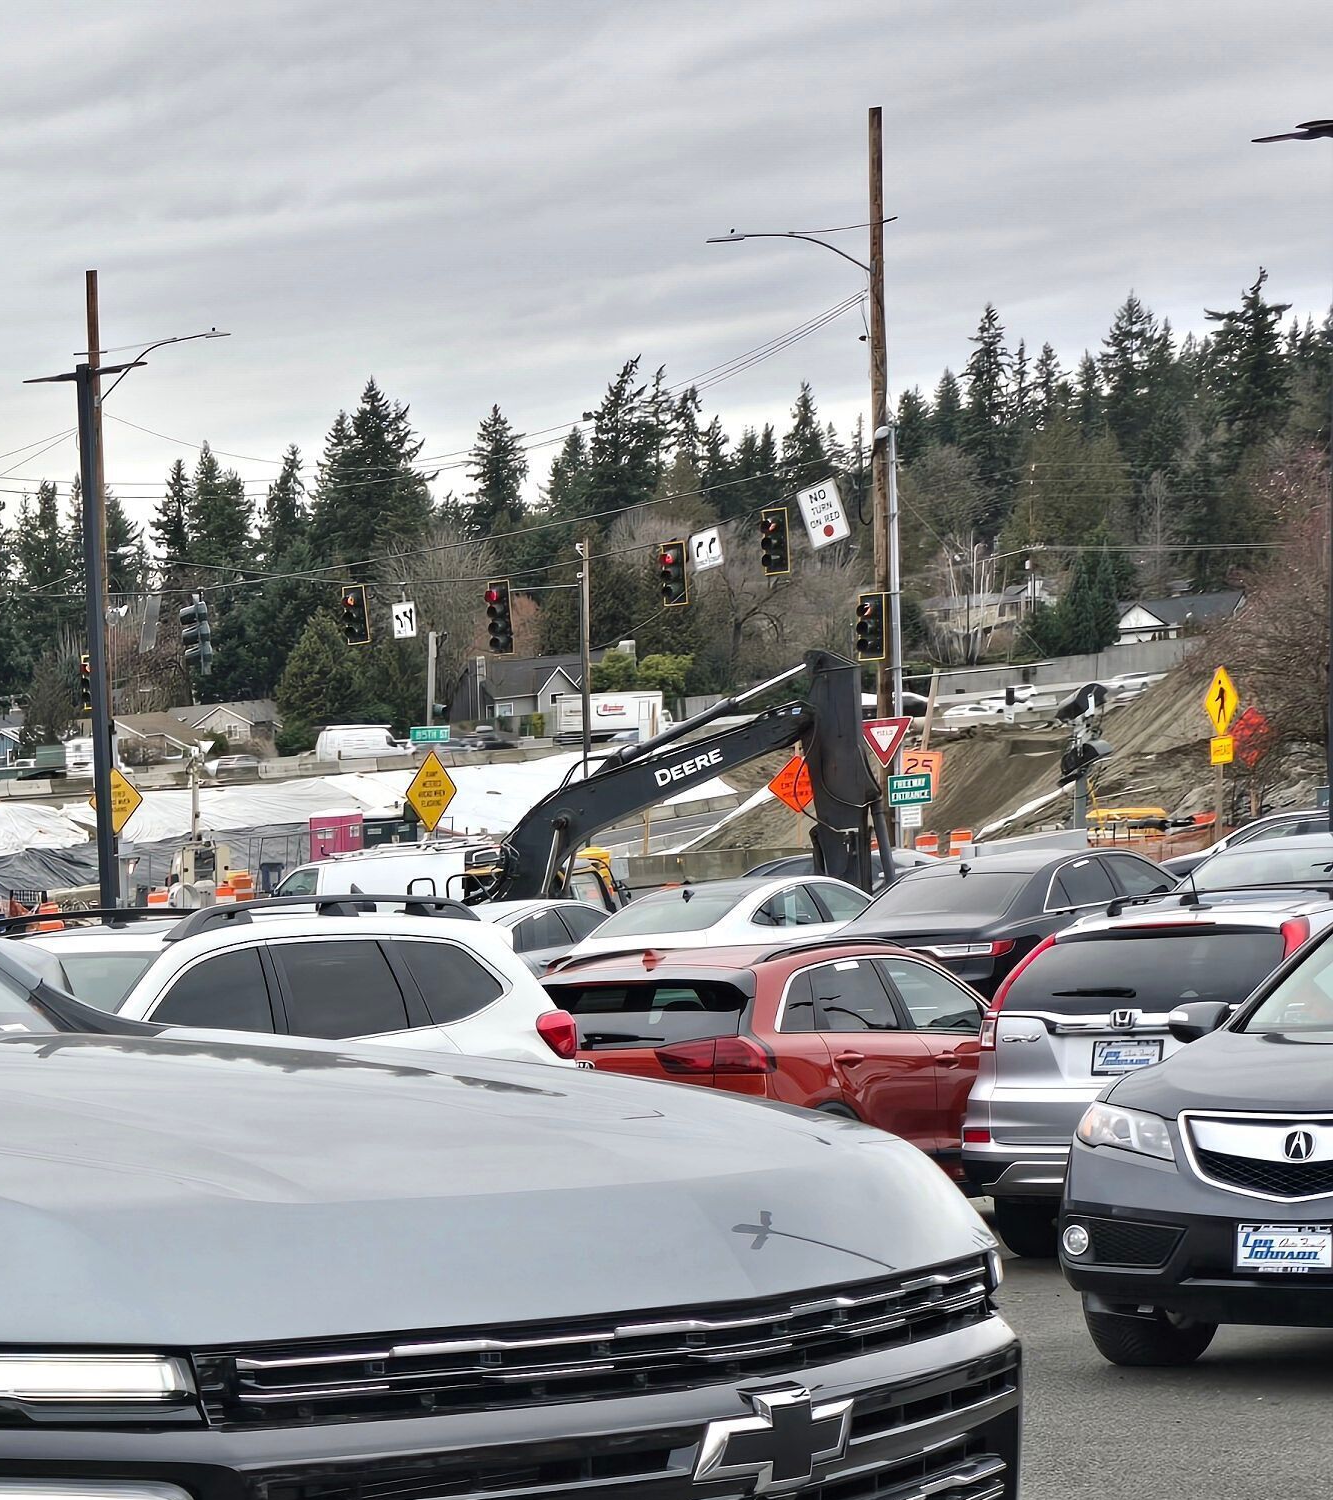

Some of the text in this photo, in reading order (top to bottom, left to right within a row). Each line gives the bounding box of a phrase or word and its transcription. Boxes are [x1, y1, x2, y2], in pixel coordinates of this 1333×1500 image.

[809, 489, 826, 504] NO
[811, 501, 833, 516] TURN
[824, 511, 839, 522] RED
[653, 748, 724, 787] DEERE
[904, 758, 933, 775] 25
